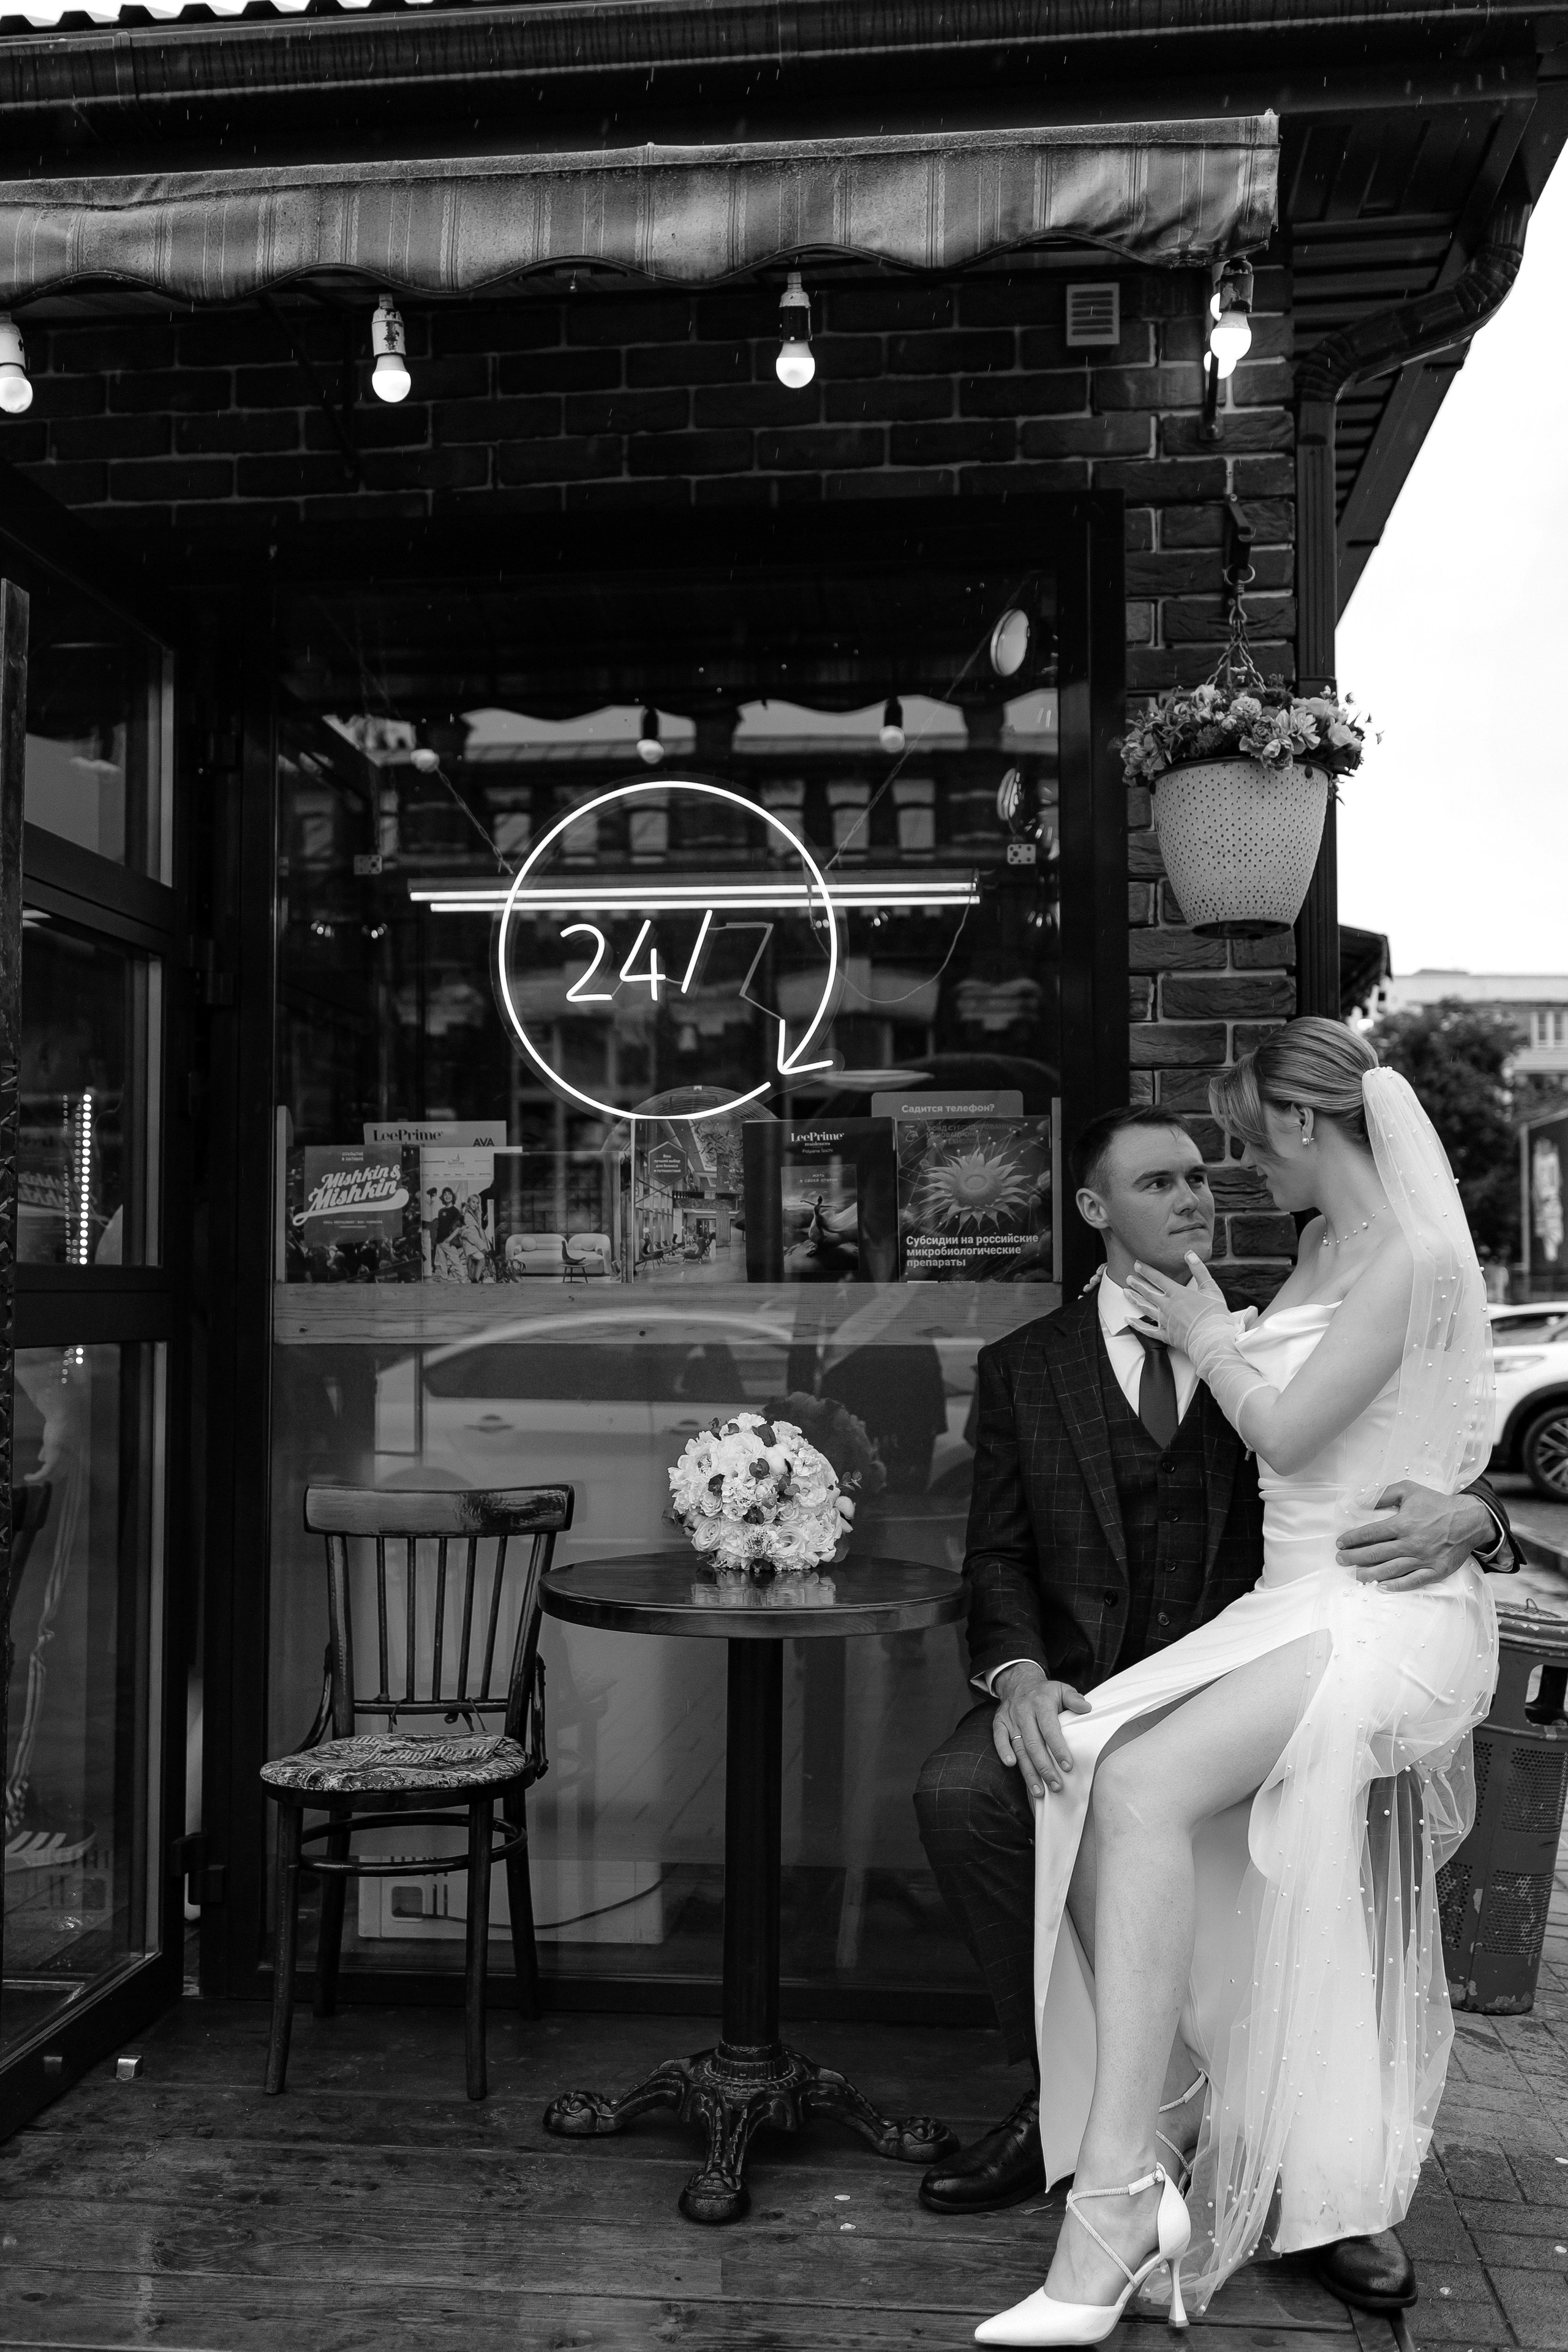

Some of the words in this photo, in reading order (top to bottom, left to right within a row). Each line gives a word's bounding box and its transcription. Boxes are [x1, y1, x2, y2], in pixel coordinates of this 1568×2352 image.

[560, 909, 774, 1001] 24/7
[946, 1104, 995, 1113] телефон?
[374, 1129, 441, 1141] LeePrime
[791, 1131, 843, 1142] LeePrime
[473, 1137, 495, 1147] AVA
[321, 1164, 389, 1189] Mishkin
[390, 1164, 401, 1180] &
[308, 1178, 397, 1212] Mishkin
[906, 1235, 958, 1247] Субсидии
[976, 1234, 1039, 1246] российские
[907, 1246, 1022, 1257] микробиологические
[907, 1259, 966, 1268] препараты
